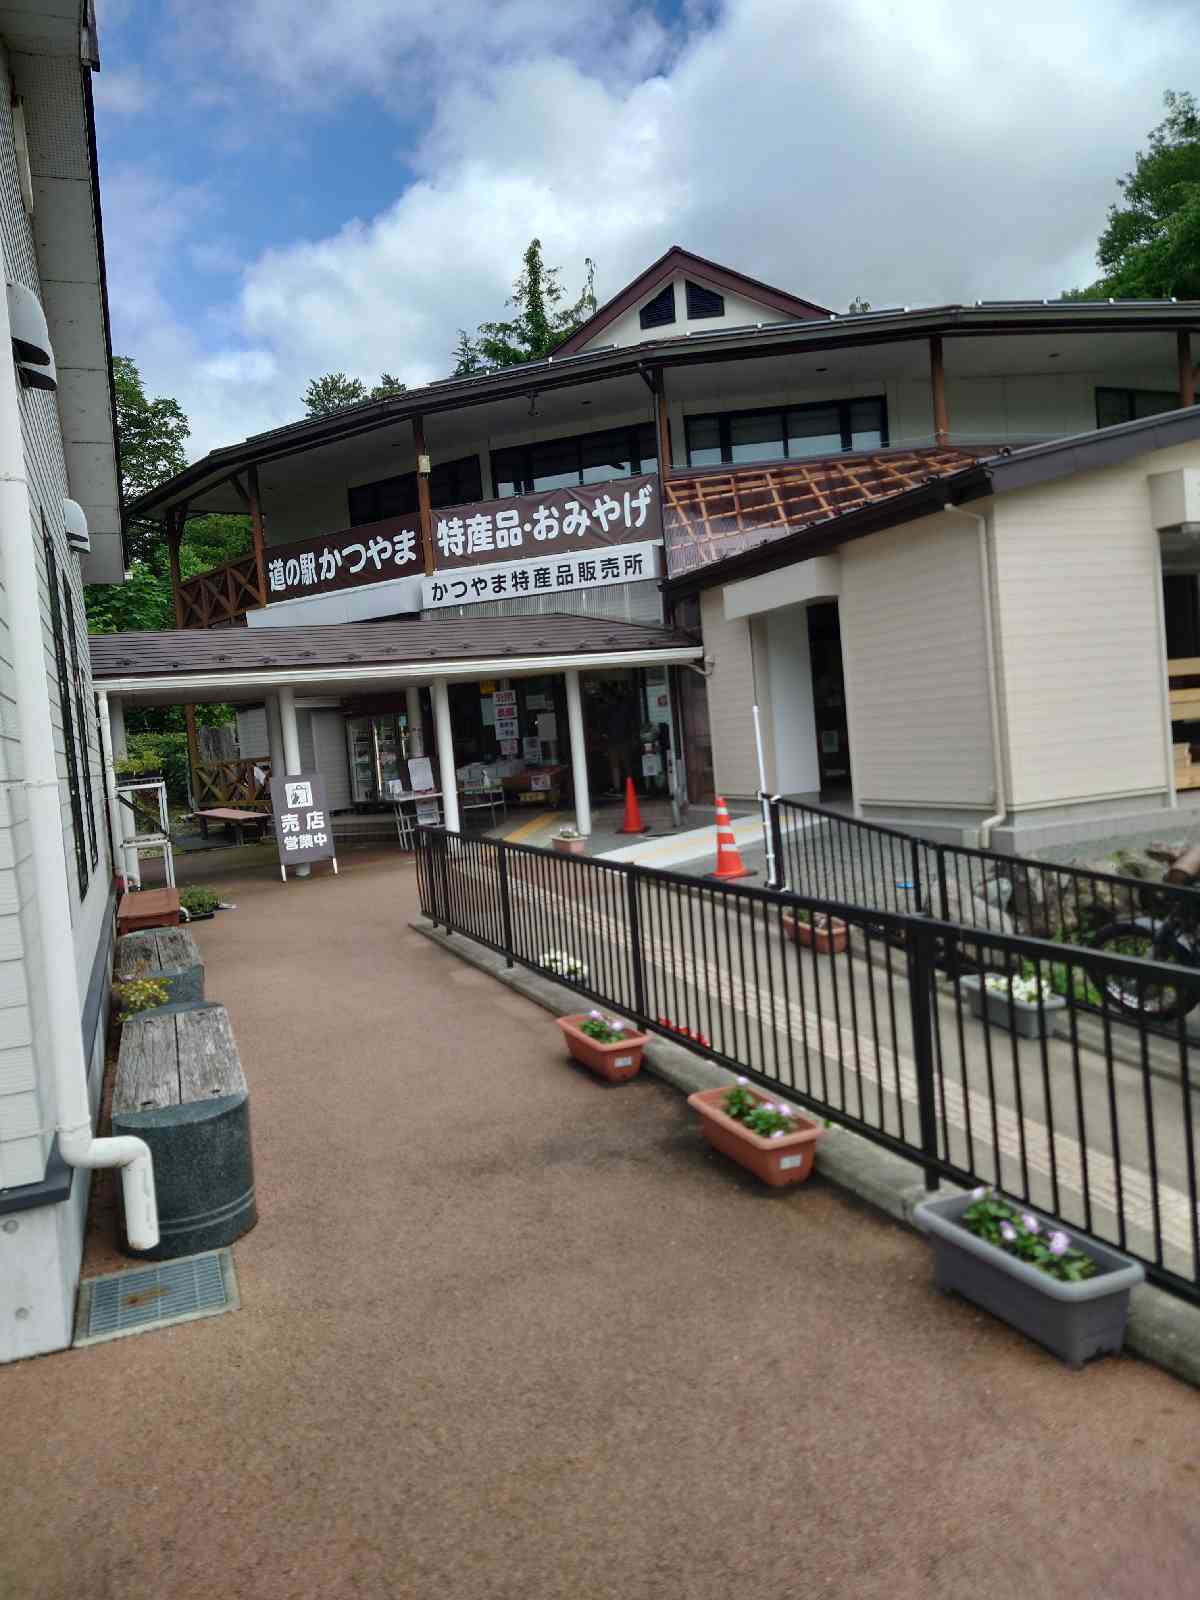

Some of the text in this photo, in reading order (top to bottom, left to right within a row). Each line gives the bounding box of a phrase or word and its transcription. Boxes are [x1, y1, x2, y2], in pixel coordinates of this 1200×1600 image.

[437, 484, 653, 557] 特産品・おみやげ
[431, 553, 643, 602] かつやま特産品販売所
[280, 811, 325, 833] 売店
[283, 832, 327, 851] 営業中
